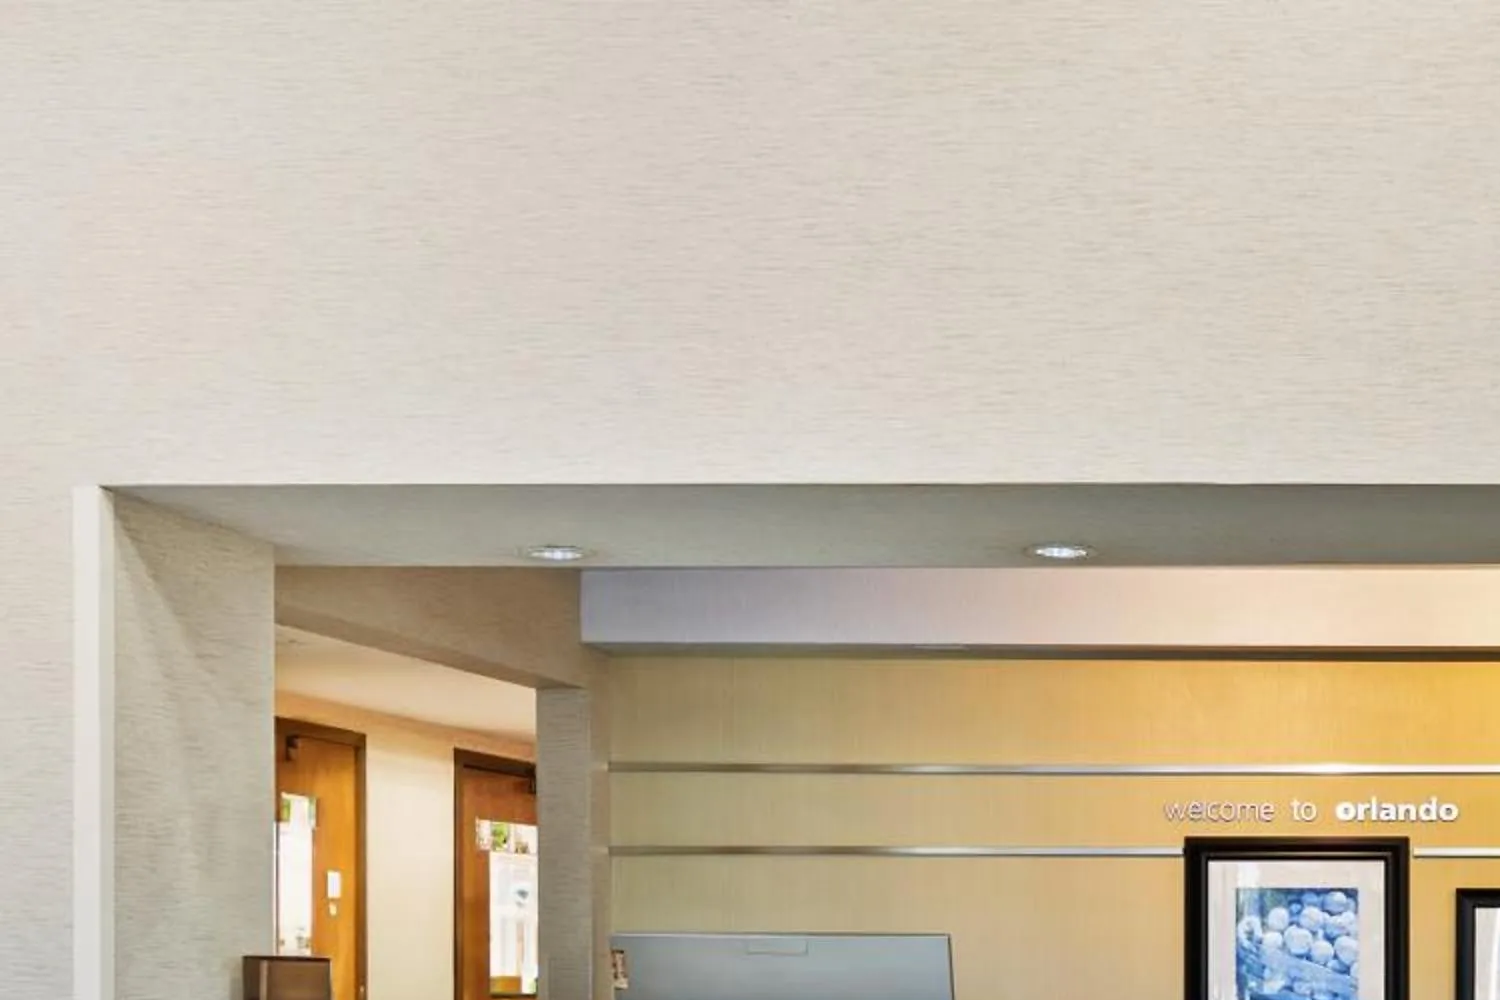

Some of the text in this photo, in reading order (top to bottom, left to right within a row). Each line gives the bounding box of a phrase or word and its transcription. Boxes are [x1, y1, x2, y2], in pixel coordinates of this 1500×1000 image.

[1164, 796, 1459, 822] welcome to orlando
